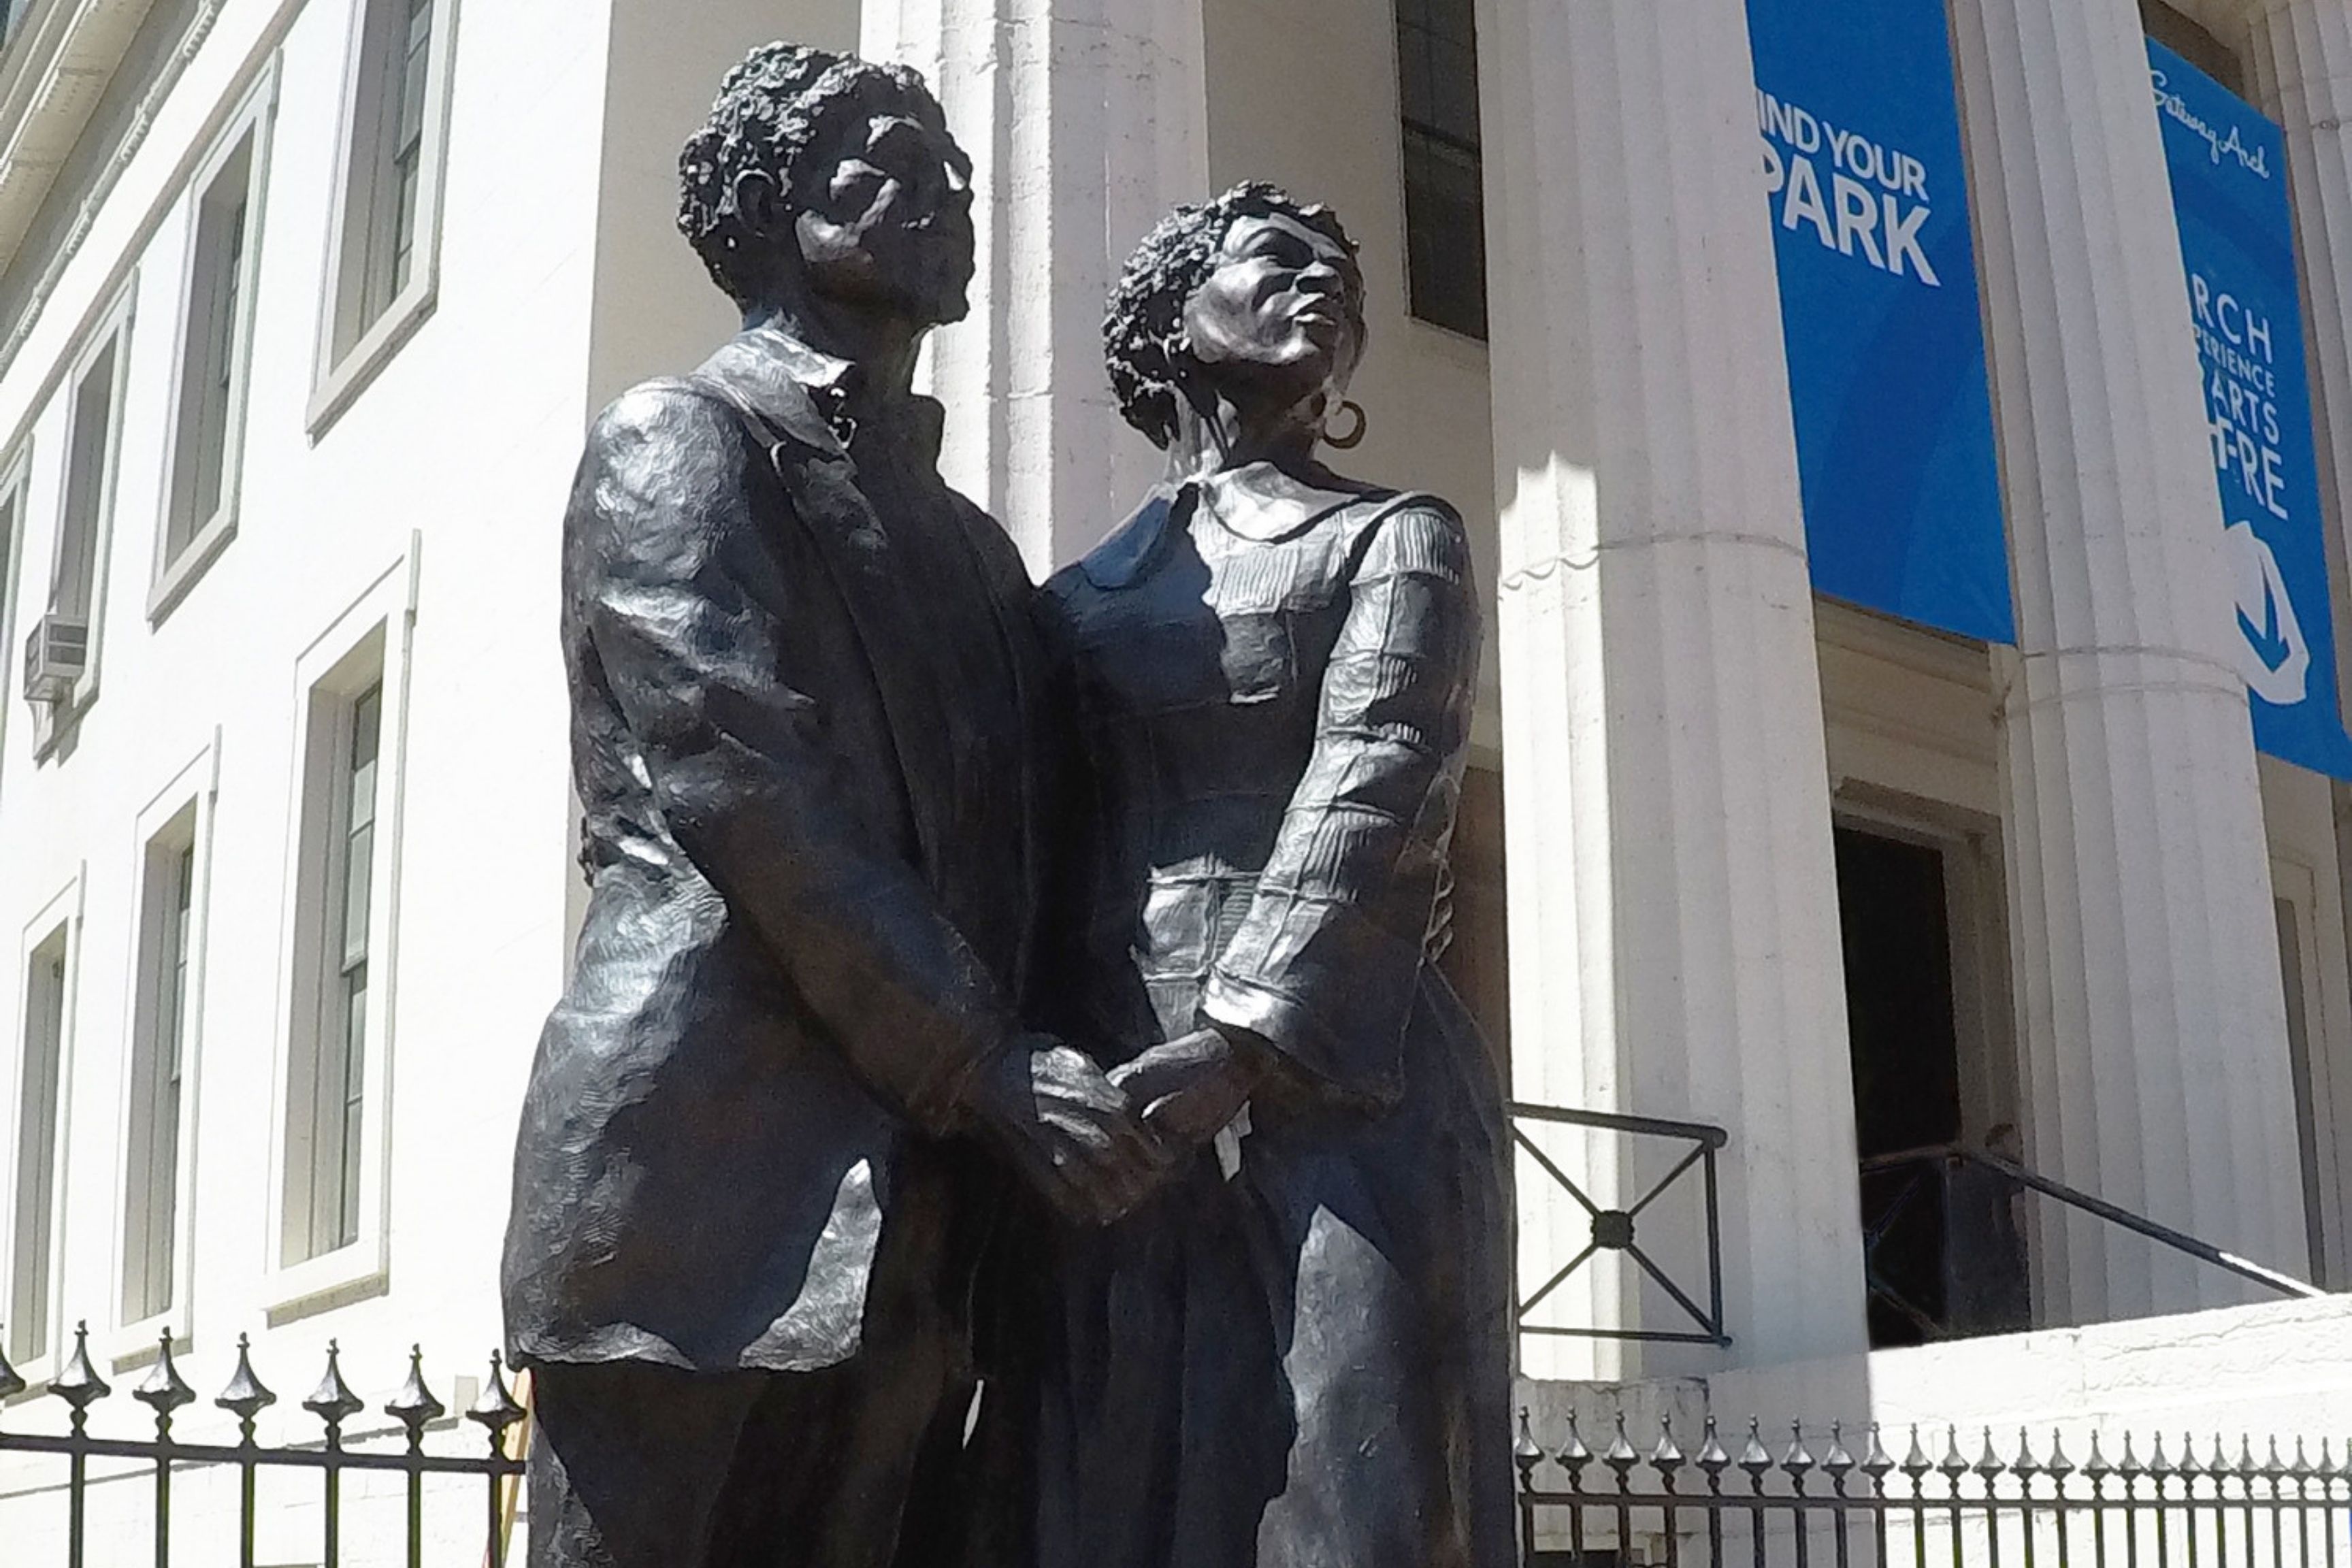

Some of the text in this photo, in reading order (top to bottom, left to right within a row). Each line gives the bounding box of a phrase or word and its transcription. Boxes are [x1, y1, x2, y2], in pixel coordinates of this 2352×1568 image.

[1757, 87, 1930, 202] IND YOUR
[1760, 135, 1942, 287] PARK
[2191, 272, 2273, 365] RCH
[2193, 323, 2276, 397] PERIENCE
[2210, 368, 2281, 446] ARTS
